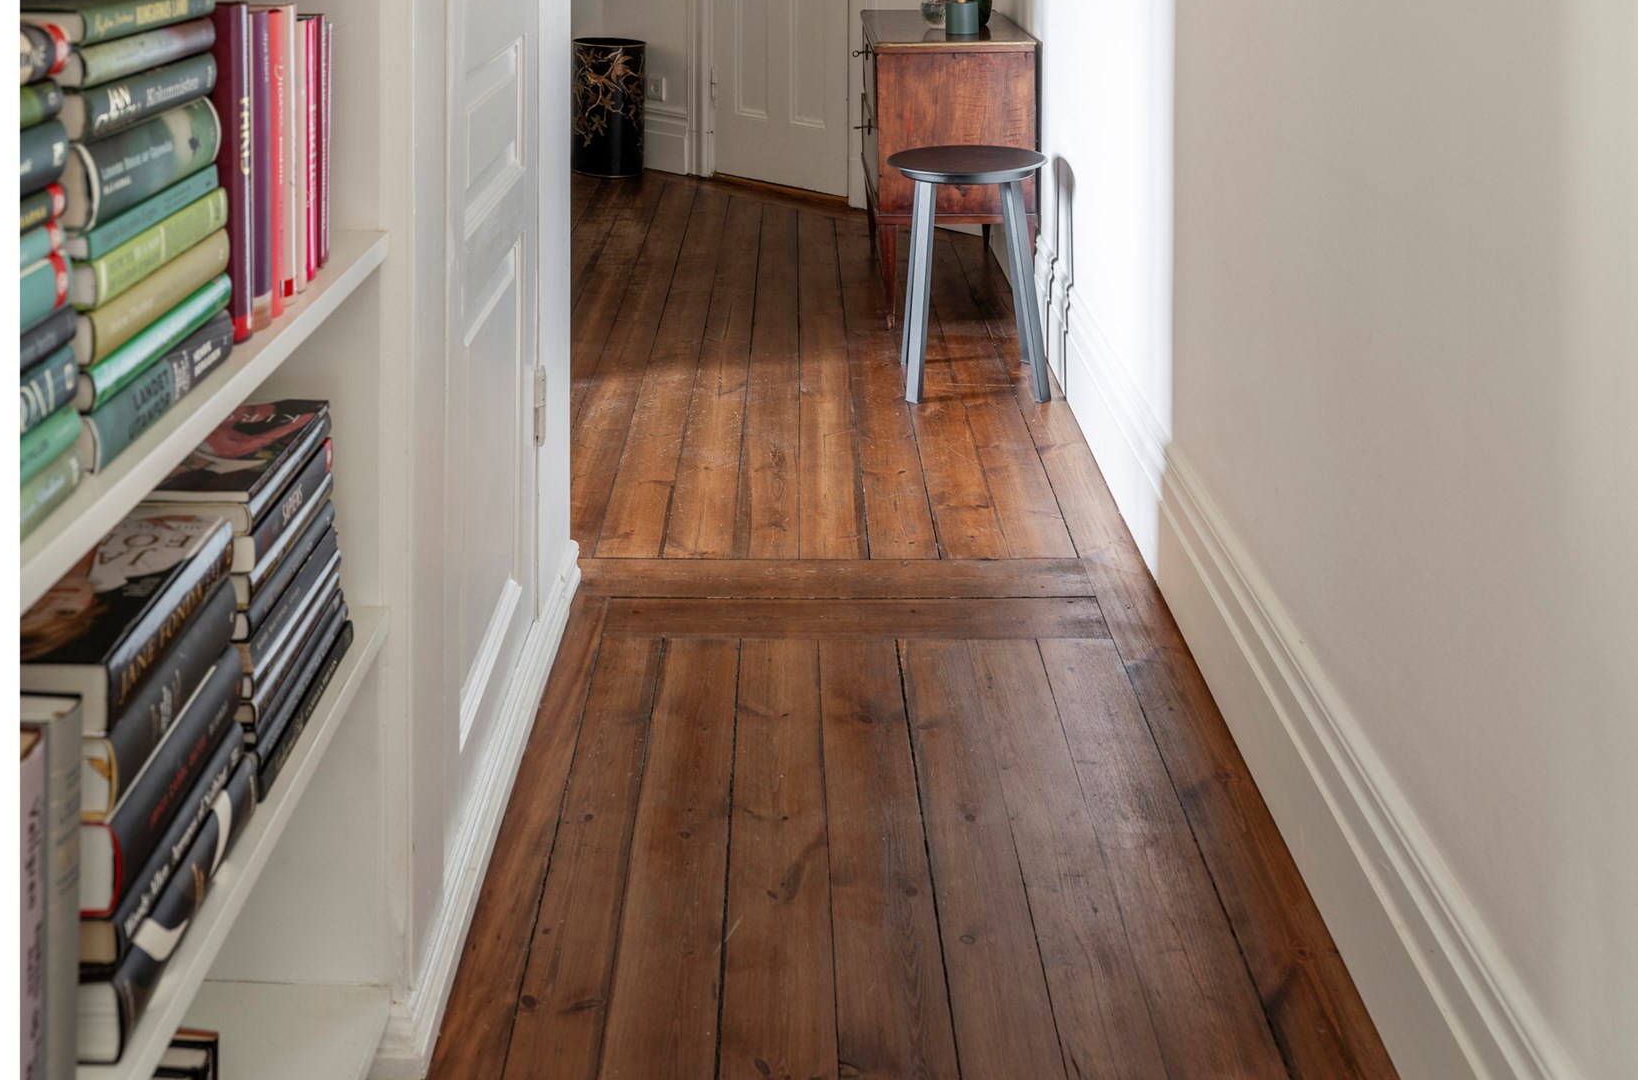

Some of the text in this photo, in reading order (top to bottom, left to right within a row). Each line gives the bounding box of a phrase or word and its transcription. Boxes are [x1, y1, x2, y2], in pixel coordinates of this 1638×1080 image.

[145, 75, 200, 107] Kolumnisten
[119, 636, 155, 706] JANE
[159, 581, 203, 650] FONDA
